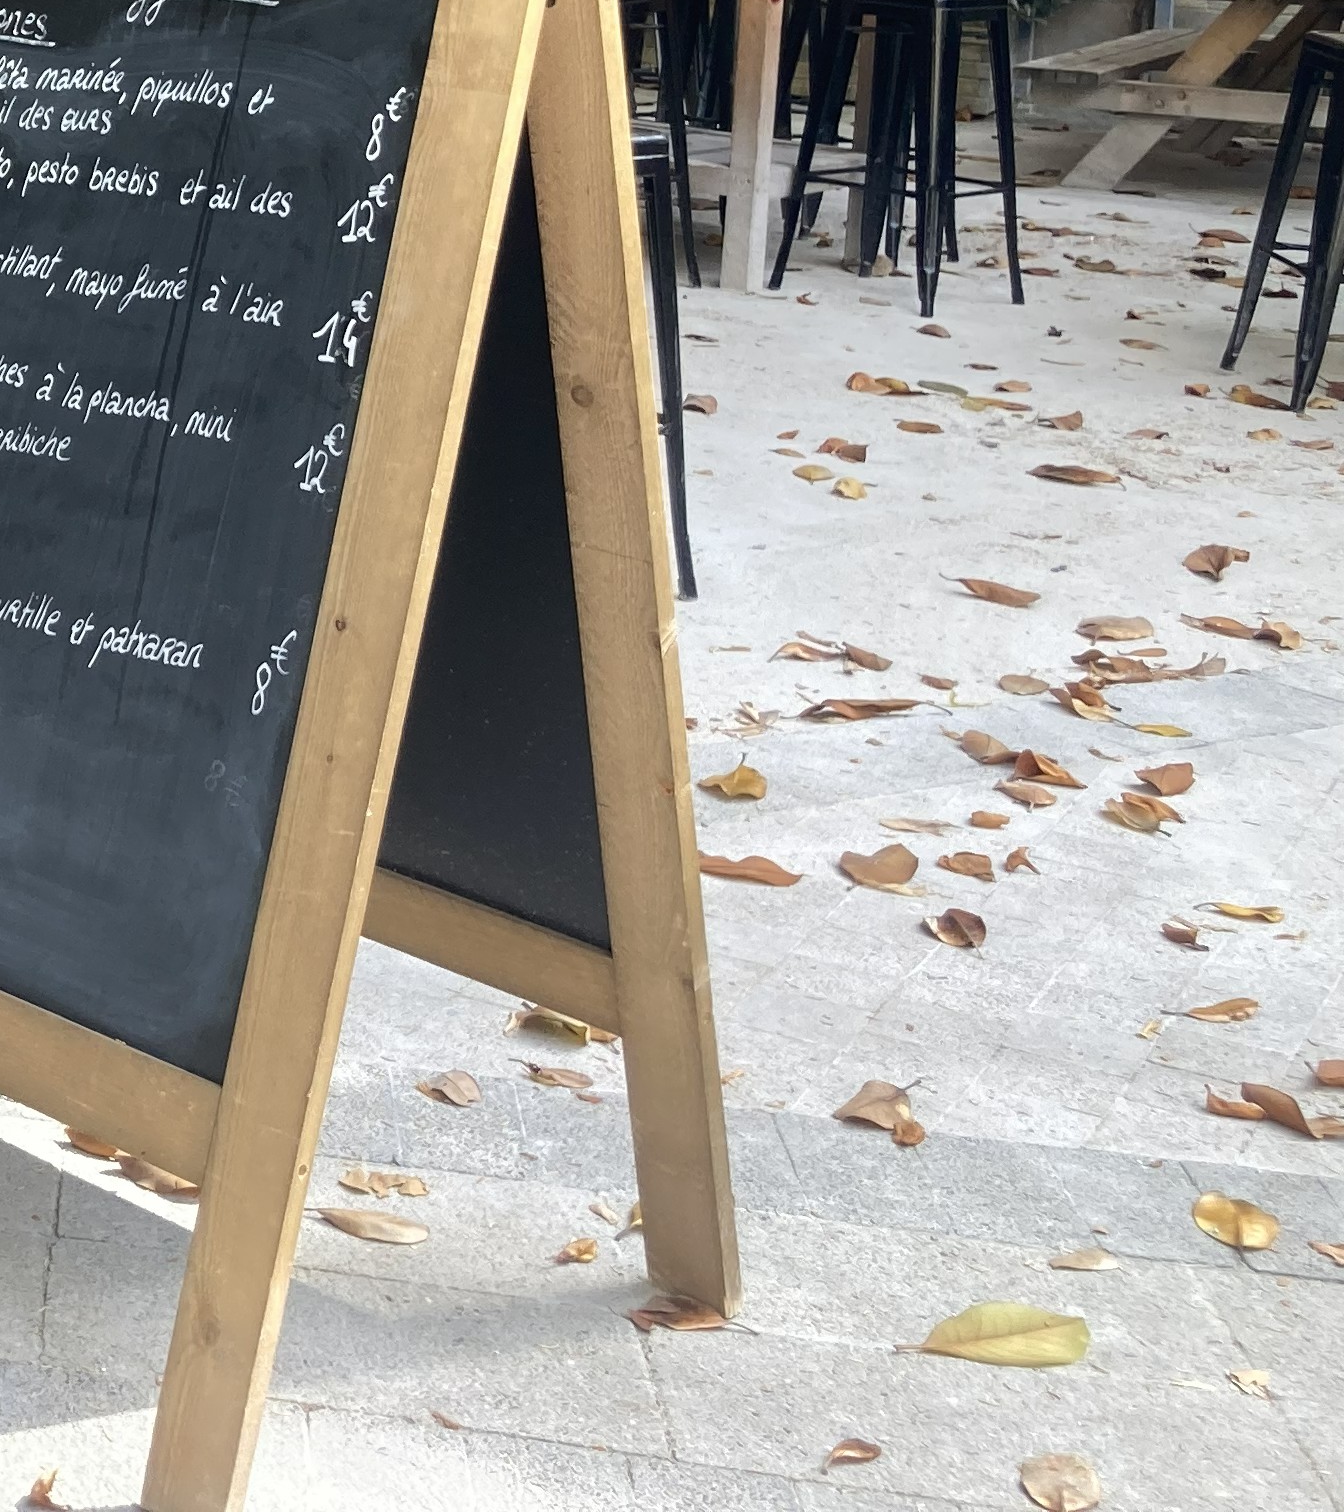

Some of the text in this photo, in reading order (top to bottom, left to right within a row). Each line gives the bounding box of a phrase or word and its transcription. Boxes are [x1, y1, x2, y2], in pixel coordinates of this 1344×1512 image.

[19, 95, 54, 131] des
[61, 108, 112, 134] ours
[35, 57, 126, 104] marinée,
[131, 69, 233, 117] piquillos
[248, 84, 274, 114] et
[22, 152, 79, 197] pesto
[89, 157, 159, 196] brebis
[180, 169, 207, 205] et
[209, 175, 239, 211] ail
[250, 182, 292, 217] des
[65, 268, 123, 310] mayo
[202, 275, 227, 312] à
[36, 363, 65, 401] à
[61, 372, 82, 410] la
[185, 406, 236, 442] mini
[70, 612, 94, 645] et
[88, 620, 203, 668] patxaran
